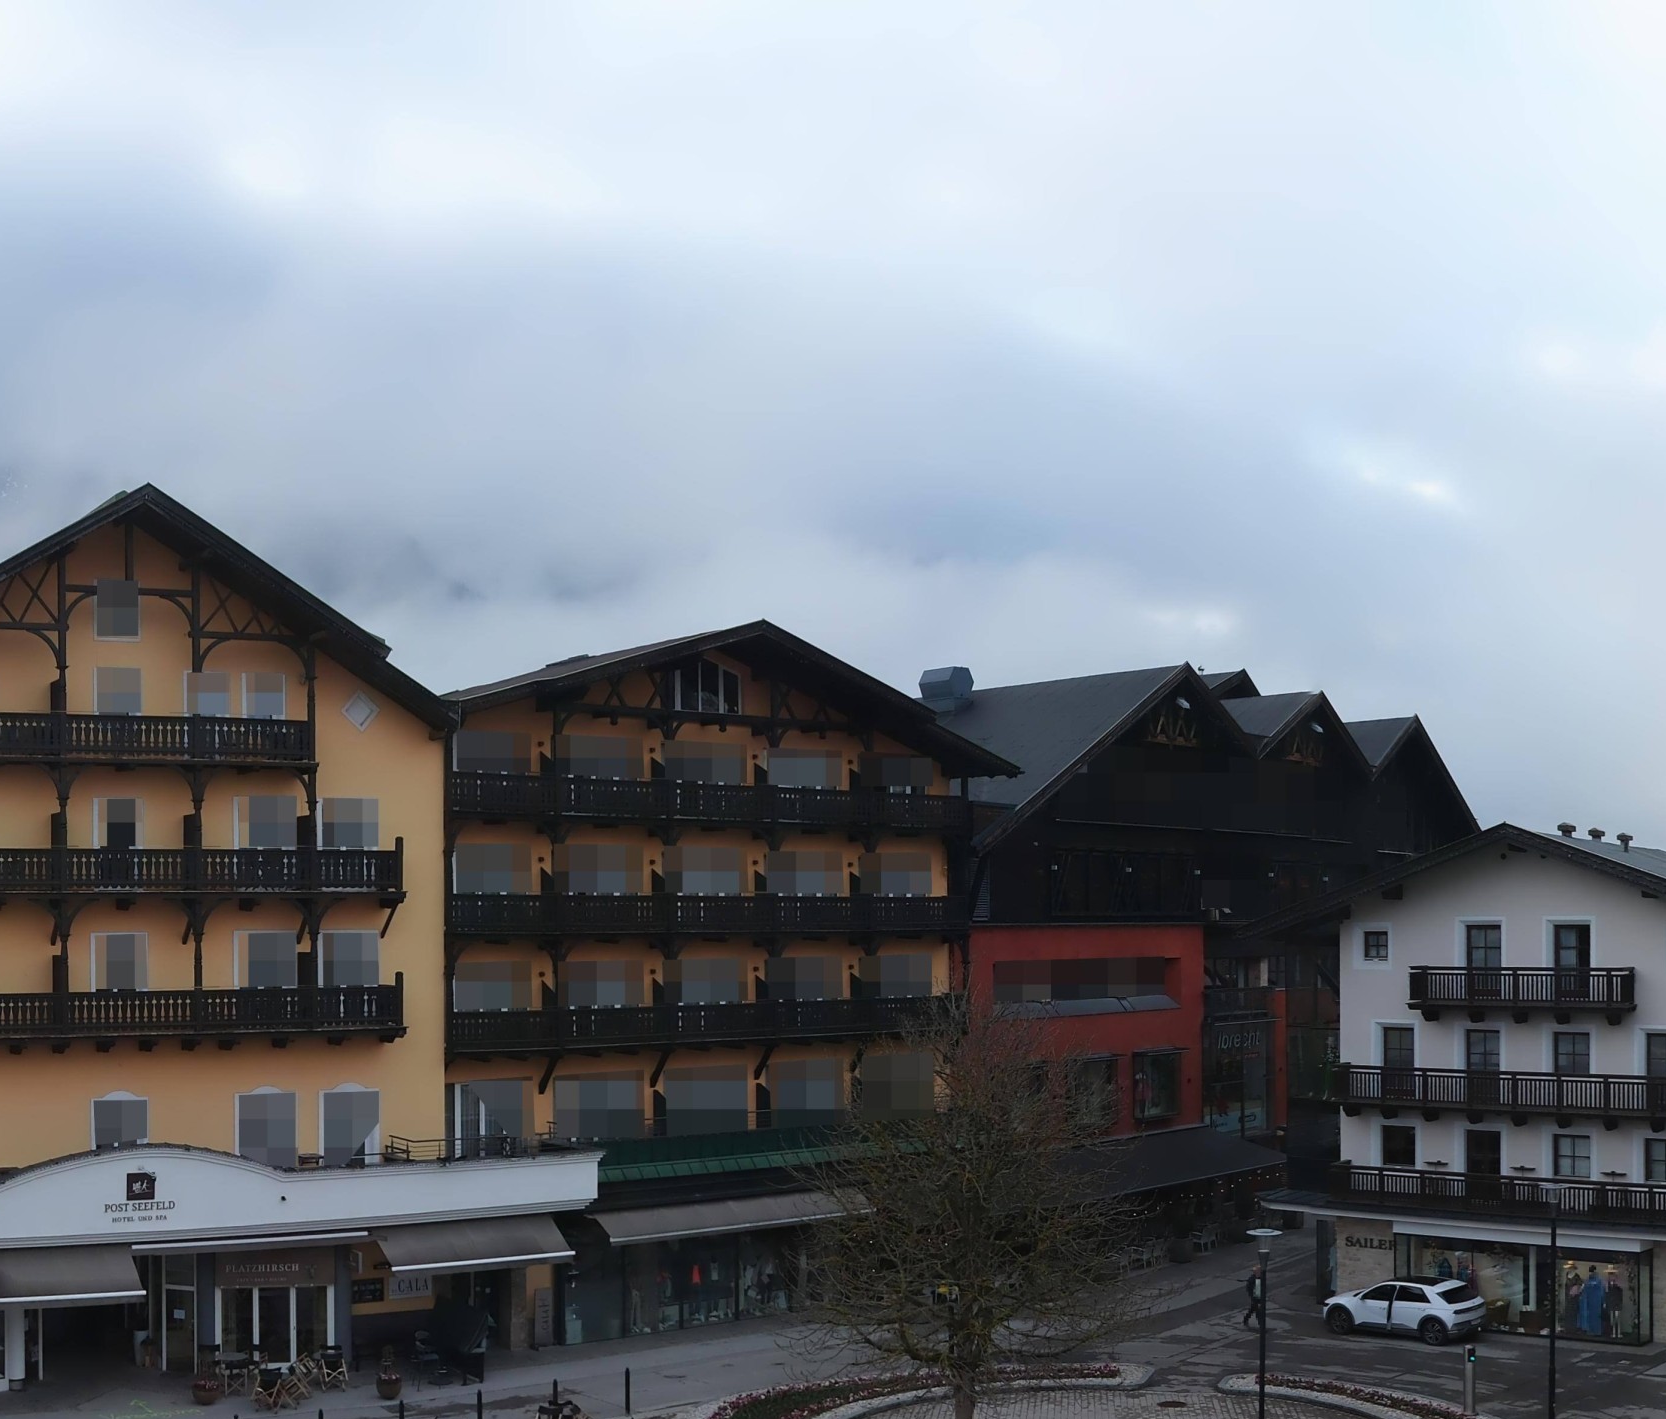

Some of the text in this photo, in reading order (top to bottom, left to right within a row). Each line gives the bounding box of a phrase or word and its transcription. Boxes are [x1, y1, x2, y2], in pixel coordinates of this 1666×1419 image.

[104, 1200, 176, 1214] POST SEEFELD
[225, 1263, 300, 1273] PLATZHIRSCH
[398, 1278, 429, 1293] CALA
